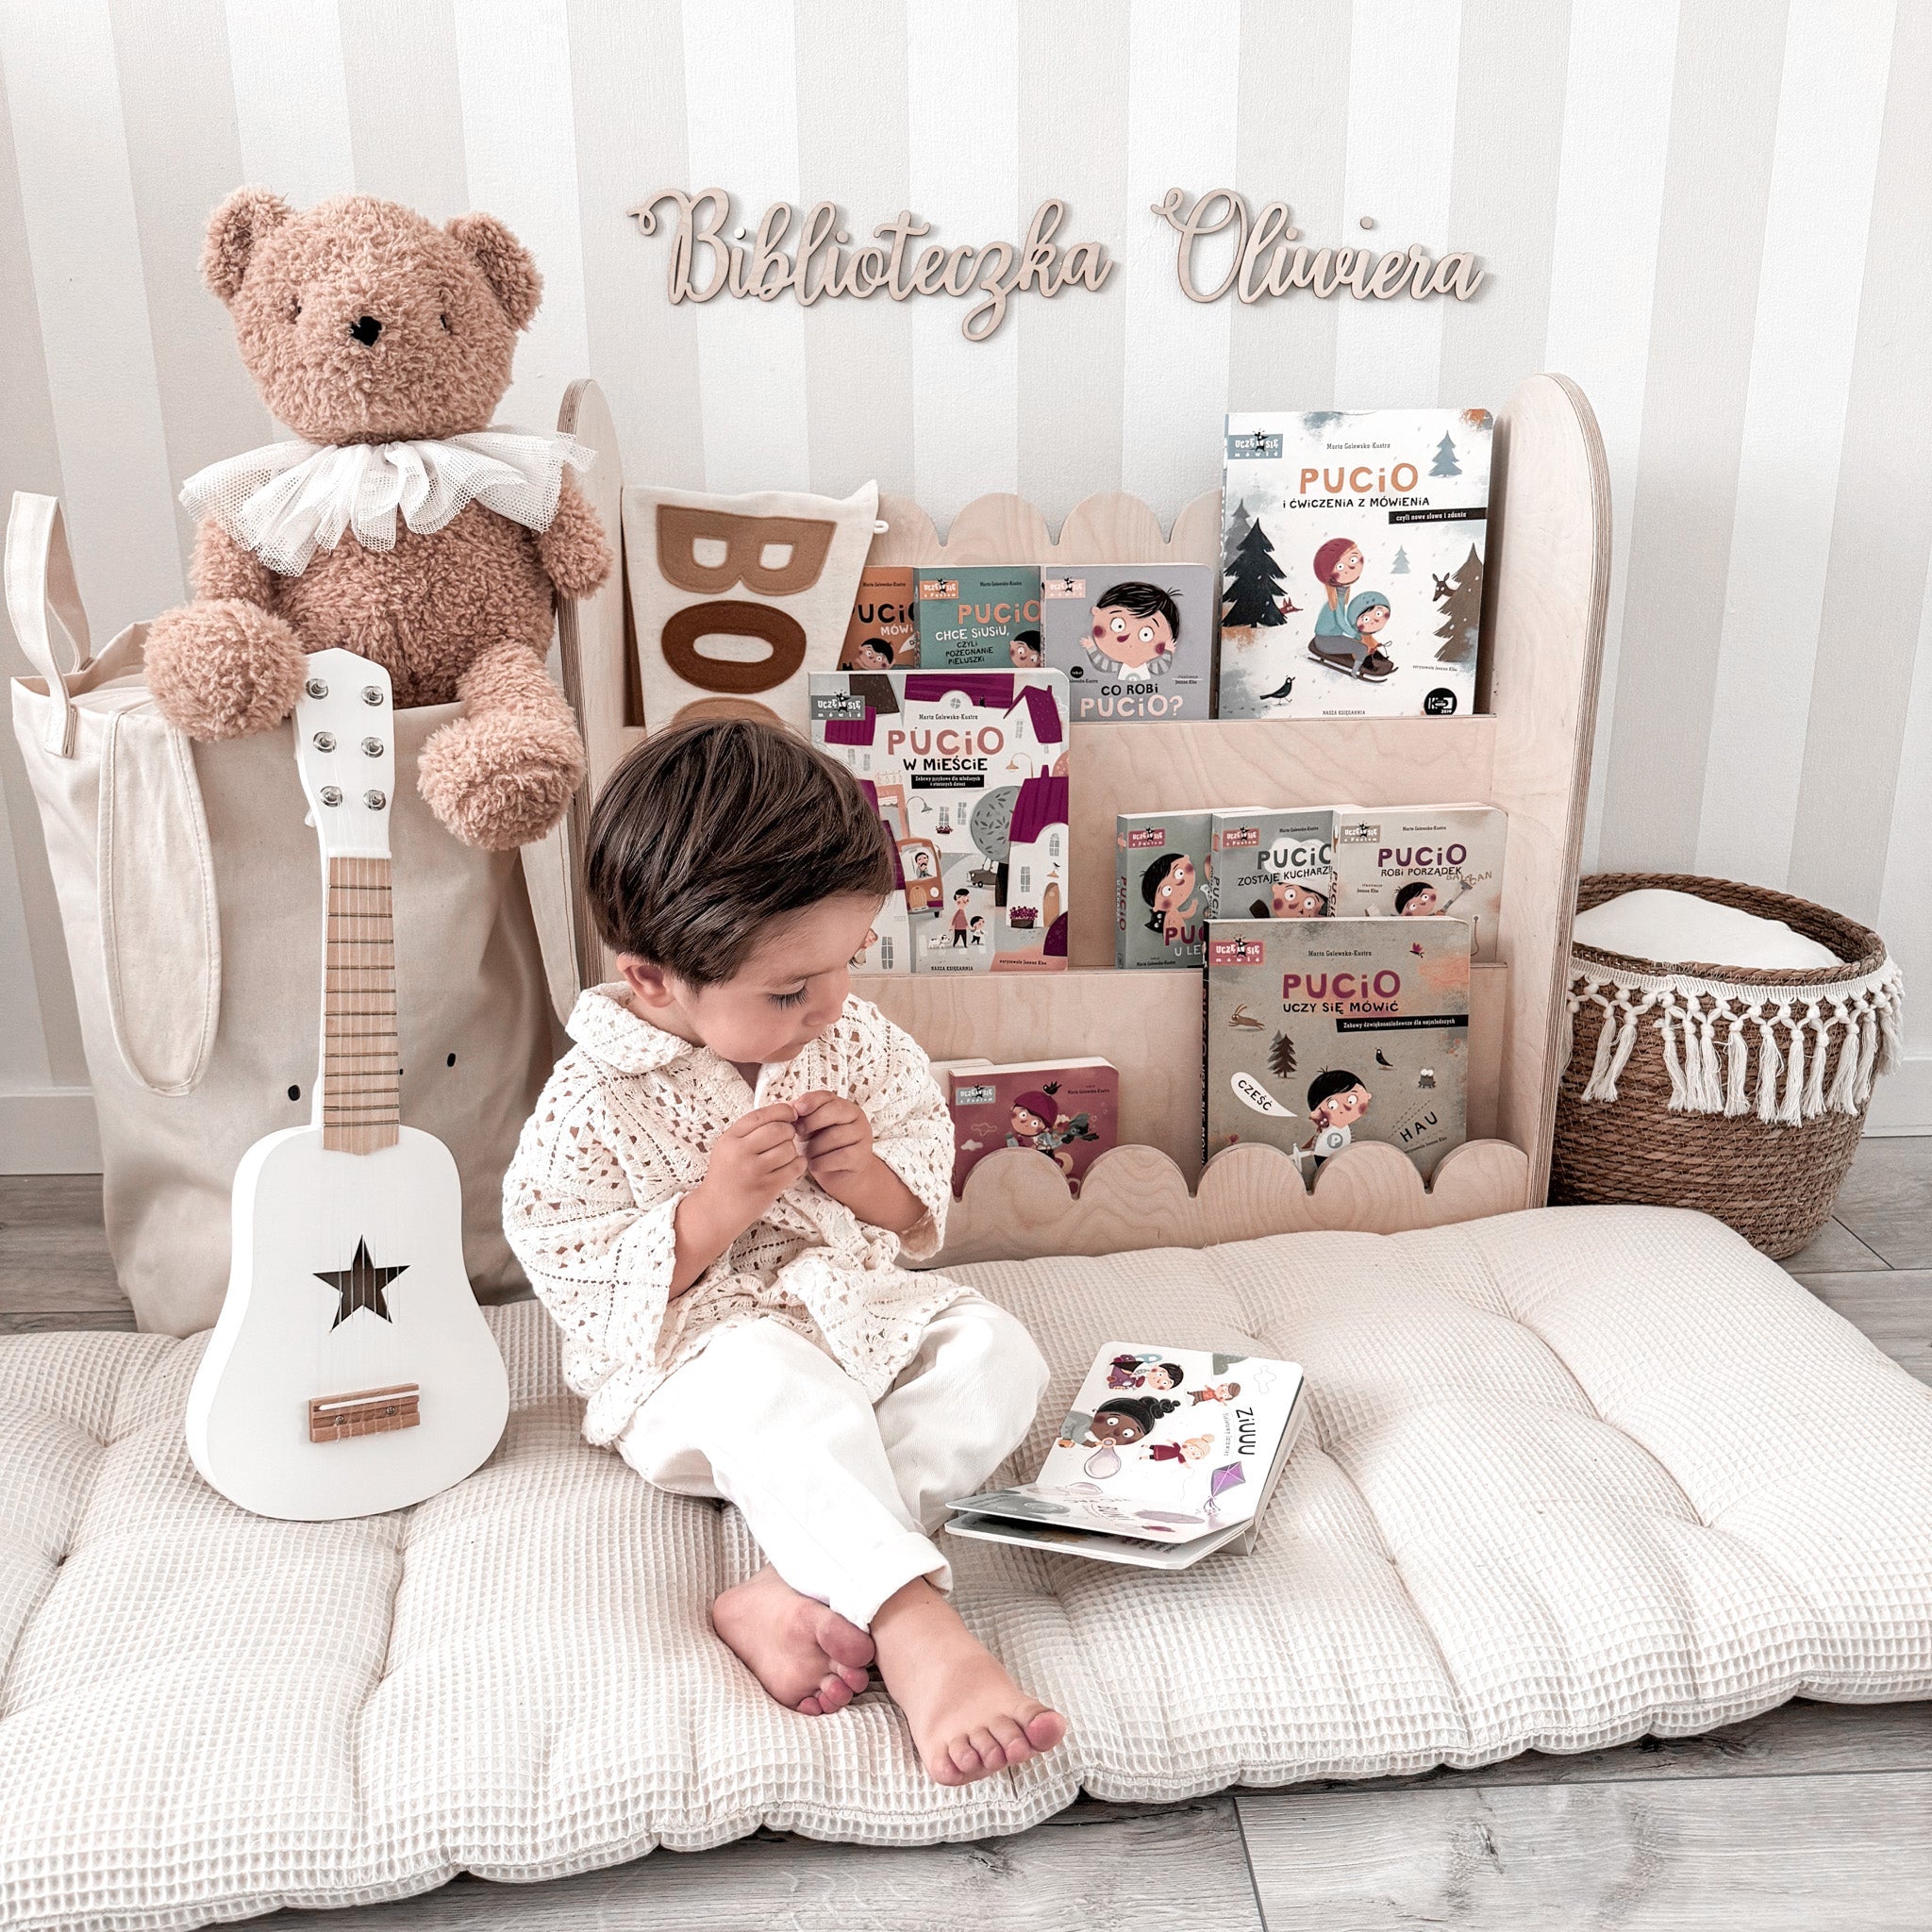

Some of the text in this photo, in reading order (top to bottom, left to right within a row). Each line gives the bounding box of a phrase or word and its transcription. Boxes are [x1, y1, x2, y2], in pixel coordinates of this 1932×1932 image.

[626, 187, 1485, 342] Biblioteczka Oliwiera
[1283, 499, 1287, 508] i
[1358, 498, 1365, 508] Z
[1395, 514, 1410, 523] czyli
[852, 602, 914, 624] UCi
[935, 628, 968, 641] CHCE
[1101, 685, 1122, 696] CO
[902, 758, 917, 771] W
[1238, 865, 1330, 887] ZOSTAJE KUCHARZ
[1283, 1003, 1317, 1013] UCZY
[1237, 1079, 1273, 1111] CZEŚĆ
[1399, 1111, 1438, 1143] HAU
